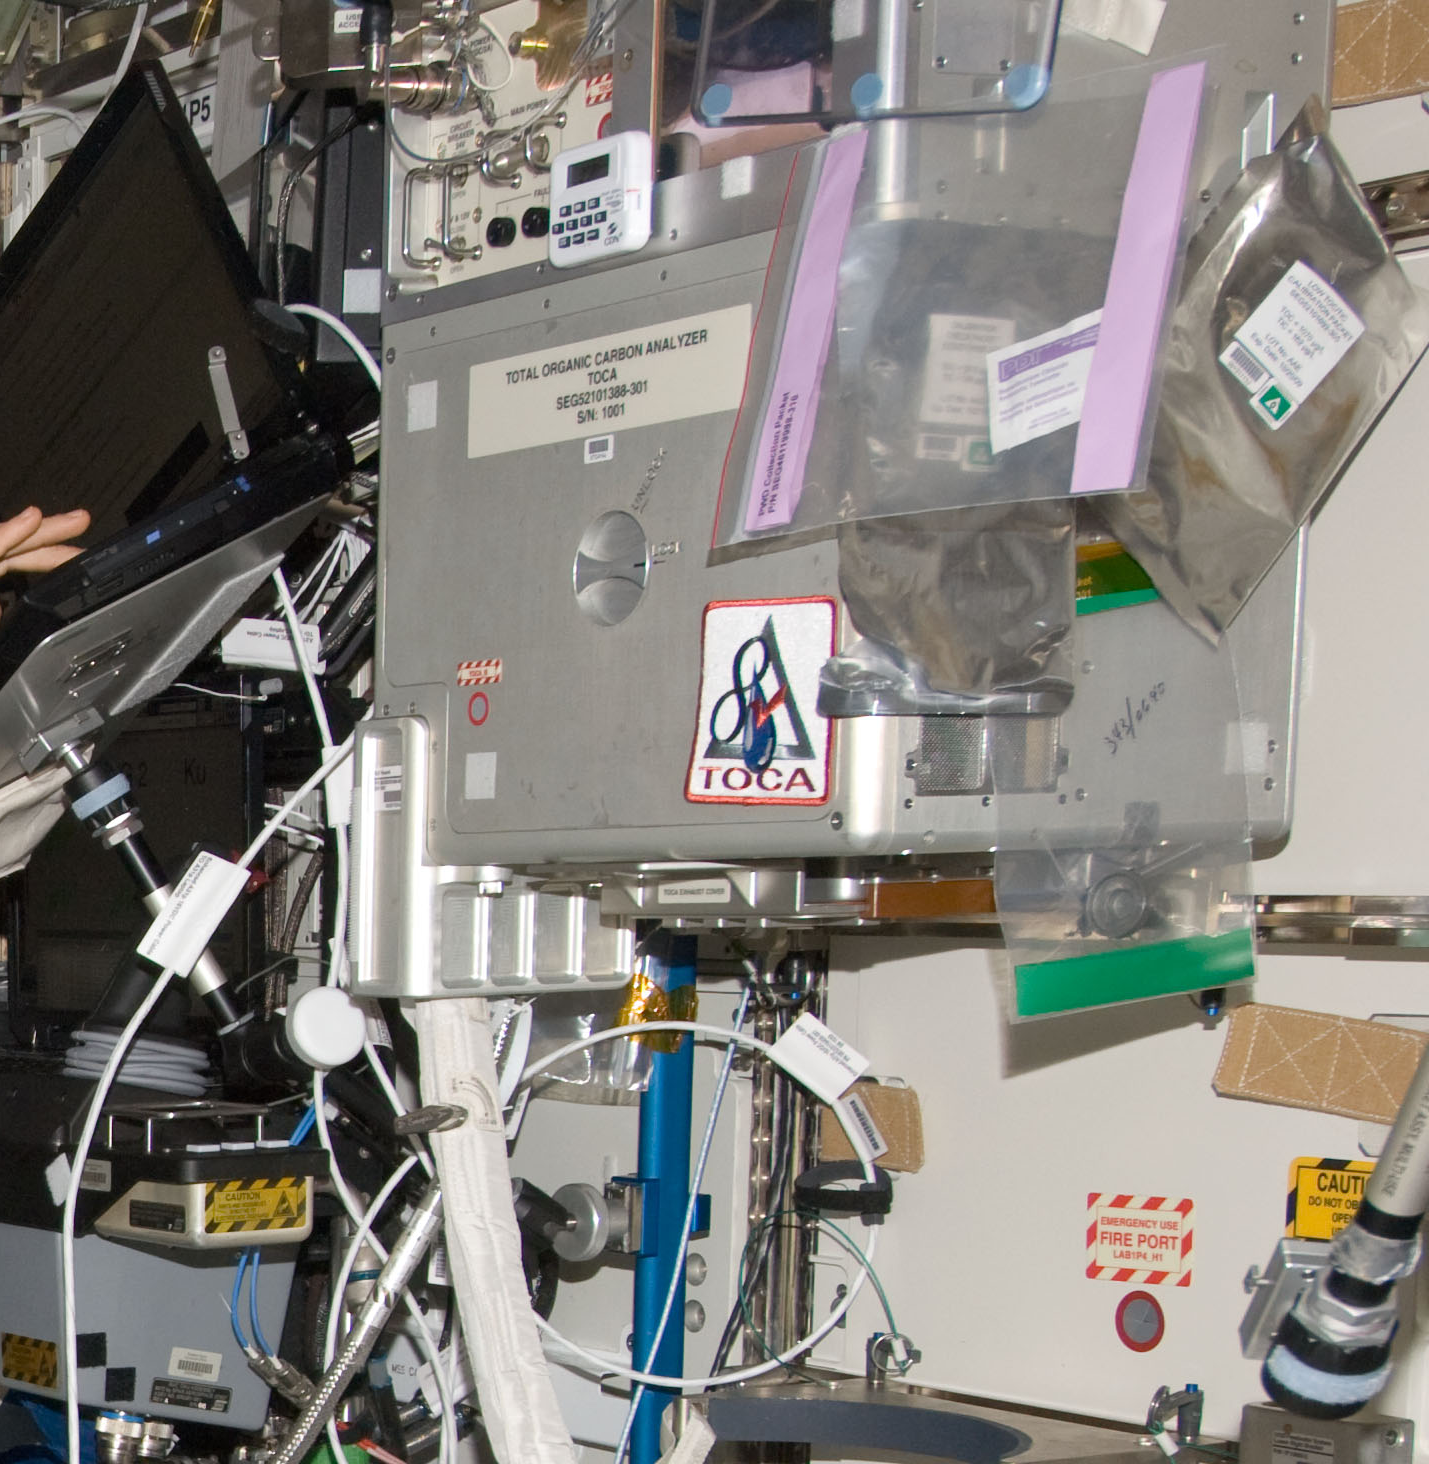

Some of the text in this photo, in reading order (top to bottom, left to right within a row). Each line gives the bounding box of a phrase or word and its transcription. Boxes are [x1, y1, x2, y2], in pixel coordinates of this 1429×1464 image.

[182, 94, 215, 126] P5
[510, 98, 549, 116] MAIN POWER
[447, 129, 476, 143] BREAKER
[505, 329, 709, 384] TOTAL ORGANIC CARBON ANALYZER
[586, 366, 618, 386] TOCA
[555, 380, 649, 410] SEG52101388-301
[575, 402, 626, 425] S/N: 1001
[761, 388, 790, 486] Collection Packet
[698, 763, 816, 793] TOCA
[190, 856, 212, 885] Enhanced
[172, 877, 190, 899] Laptop
[154, 918, 171, 939] Power
[144, 937, 160, 956] Cable
[1316, 1172, 1364, 1194] CAUTI
[225, 1192, 261, 1201] CAUTION
[1308, 1195, 1321, 1206] DO
[1324, 1196, 1341, 1207] NOT
[1100, 1217, 1178, 1230] EMERGENCY USE
[1100, 1231, 1178, 1250] FIRE PORT
